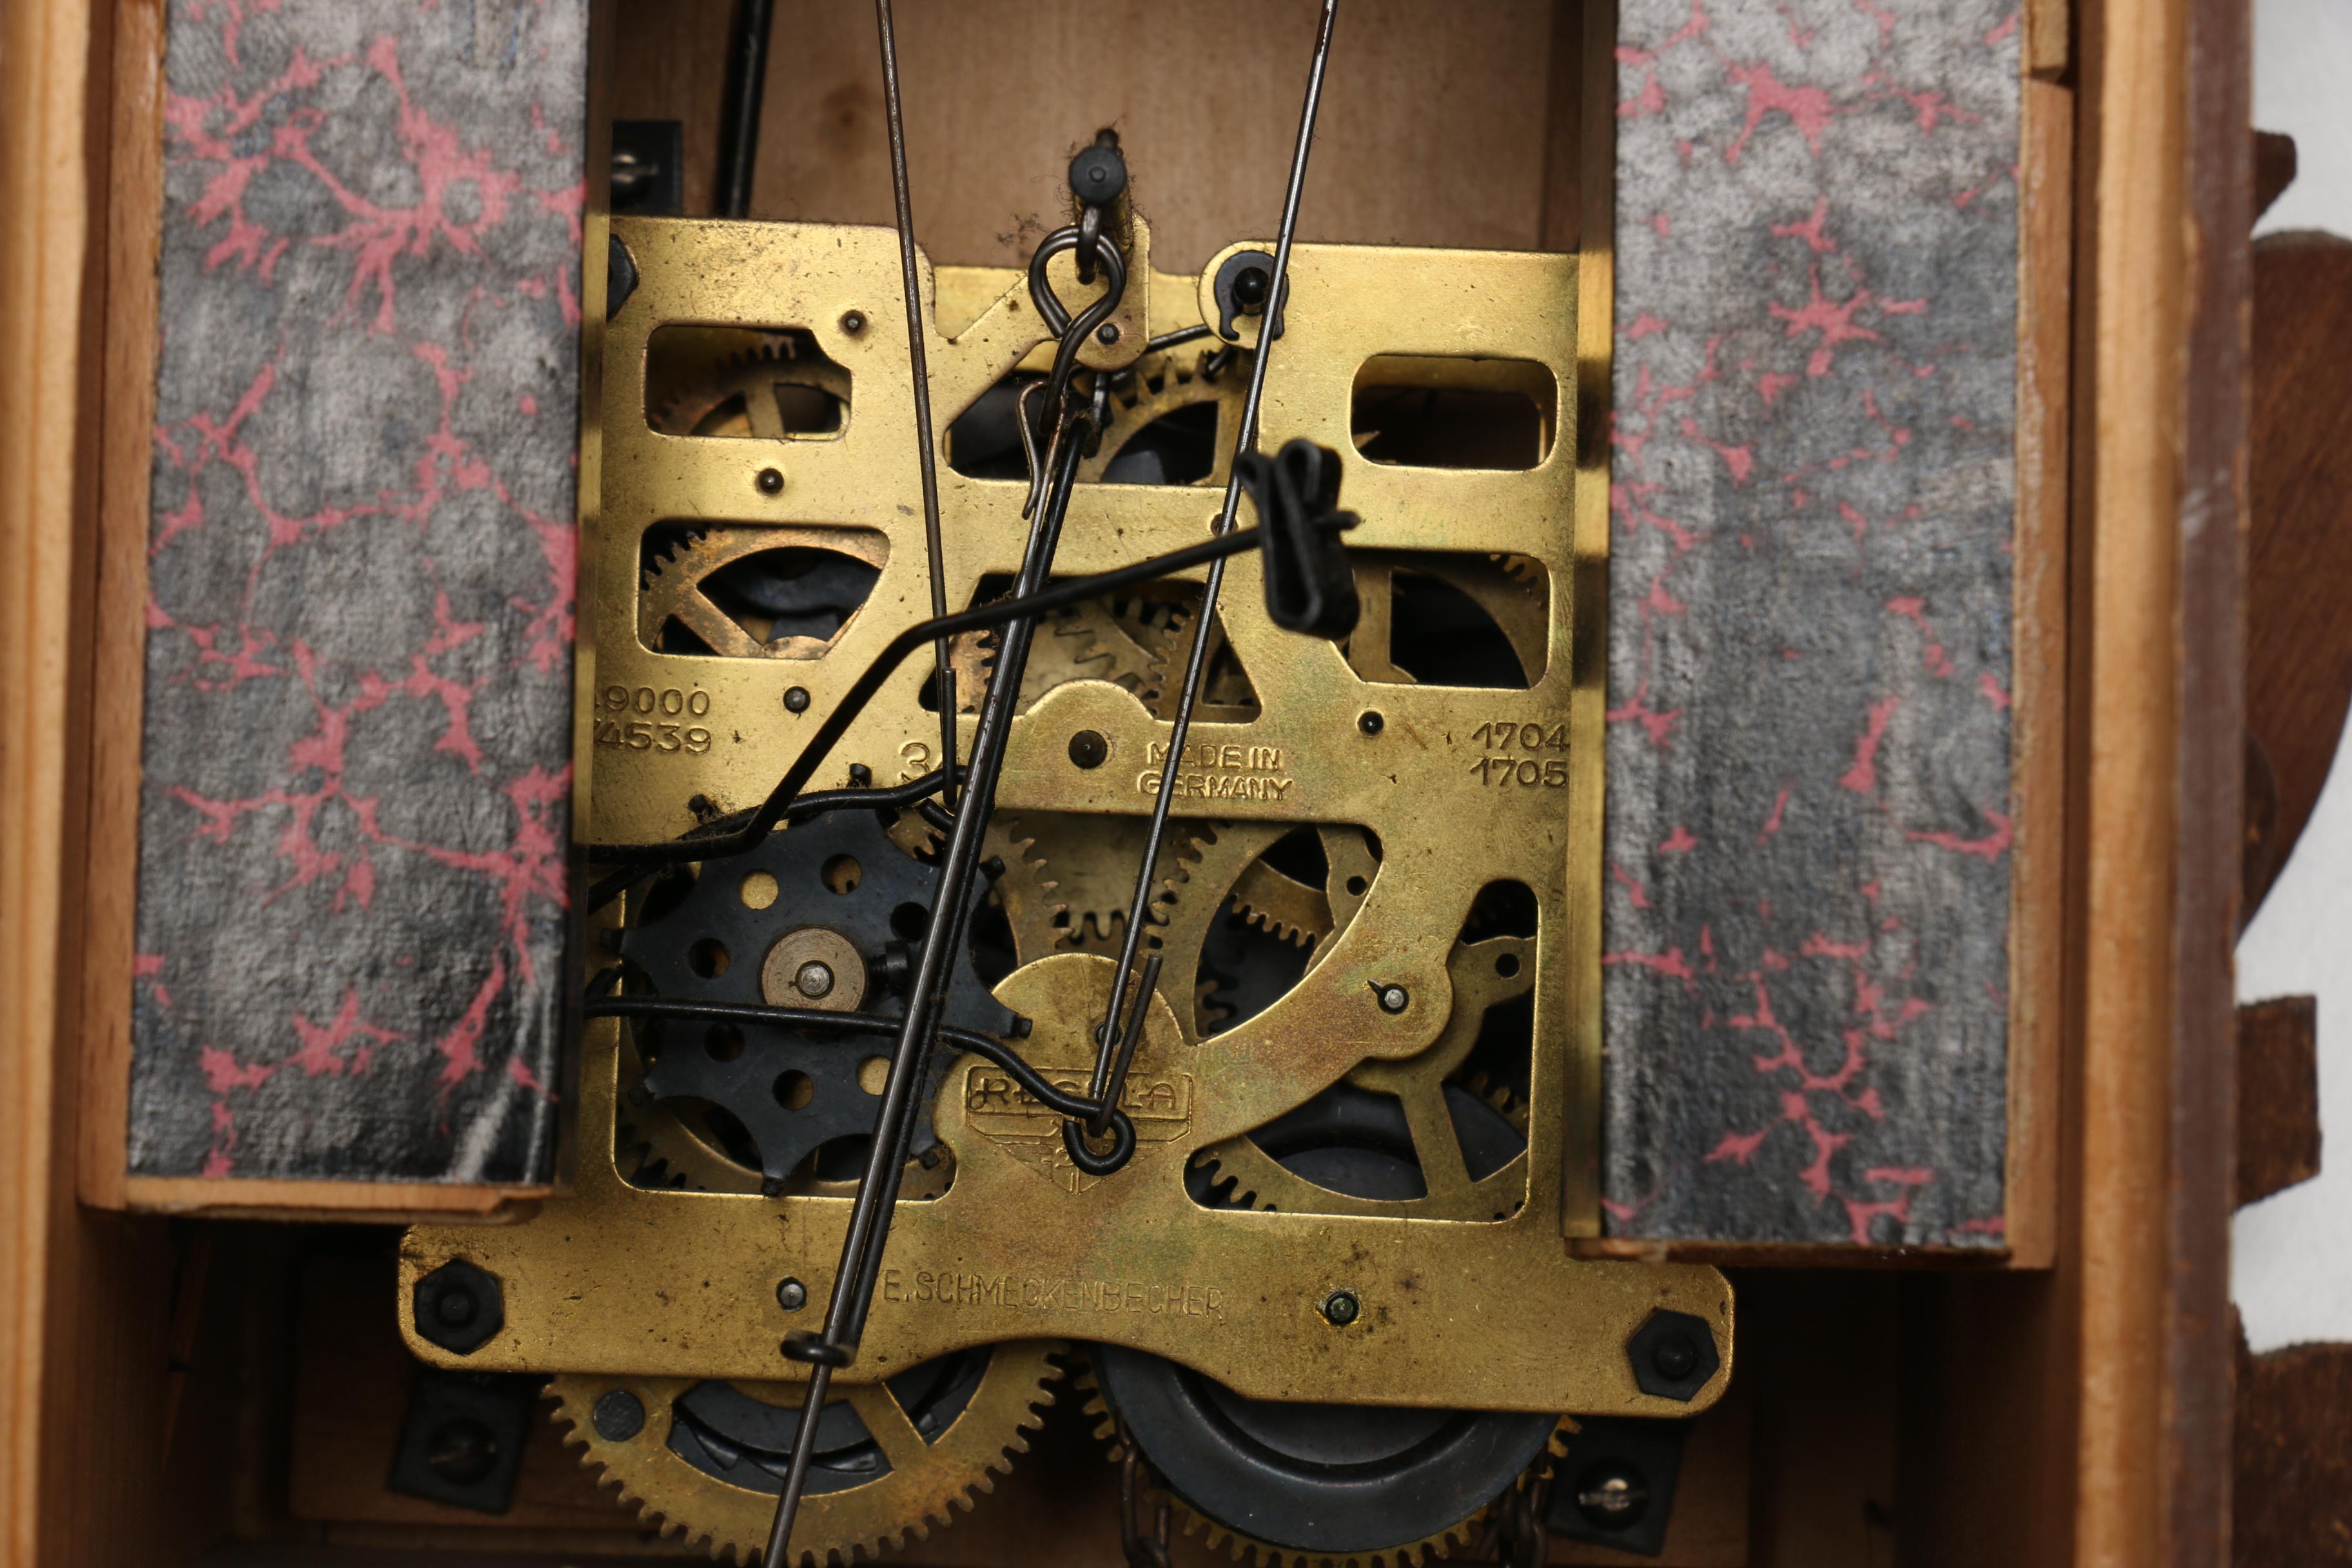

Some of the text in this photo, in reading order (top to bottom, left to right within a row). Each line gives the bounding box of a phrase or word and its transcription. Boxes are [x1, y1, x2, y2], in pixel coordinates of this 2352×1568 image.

[594, 685, 710, 716] 9000
[594, 719, 711, 754] 4539
[1471, 721, 1571, 752] 1704
[1147, 741, 1282, 771] MADE IN
[1469, 756, 1569, 788] 1705
